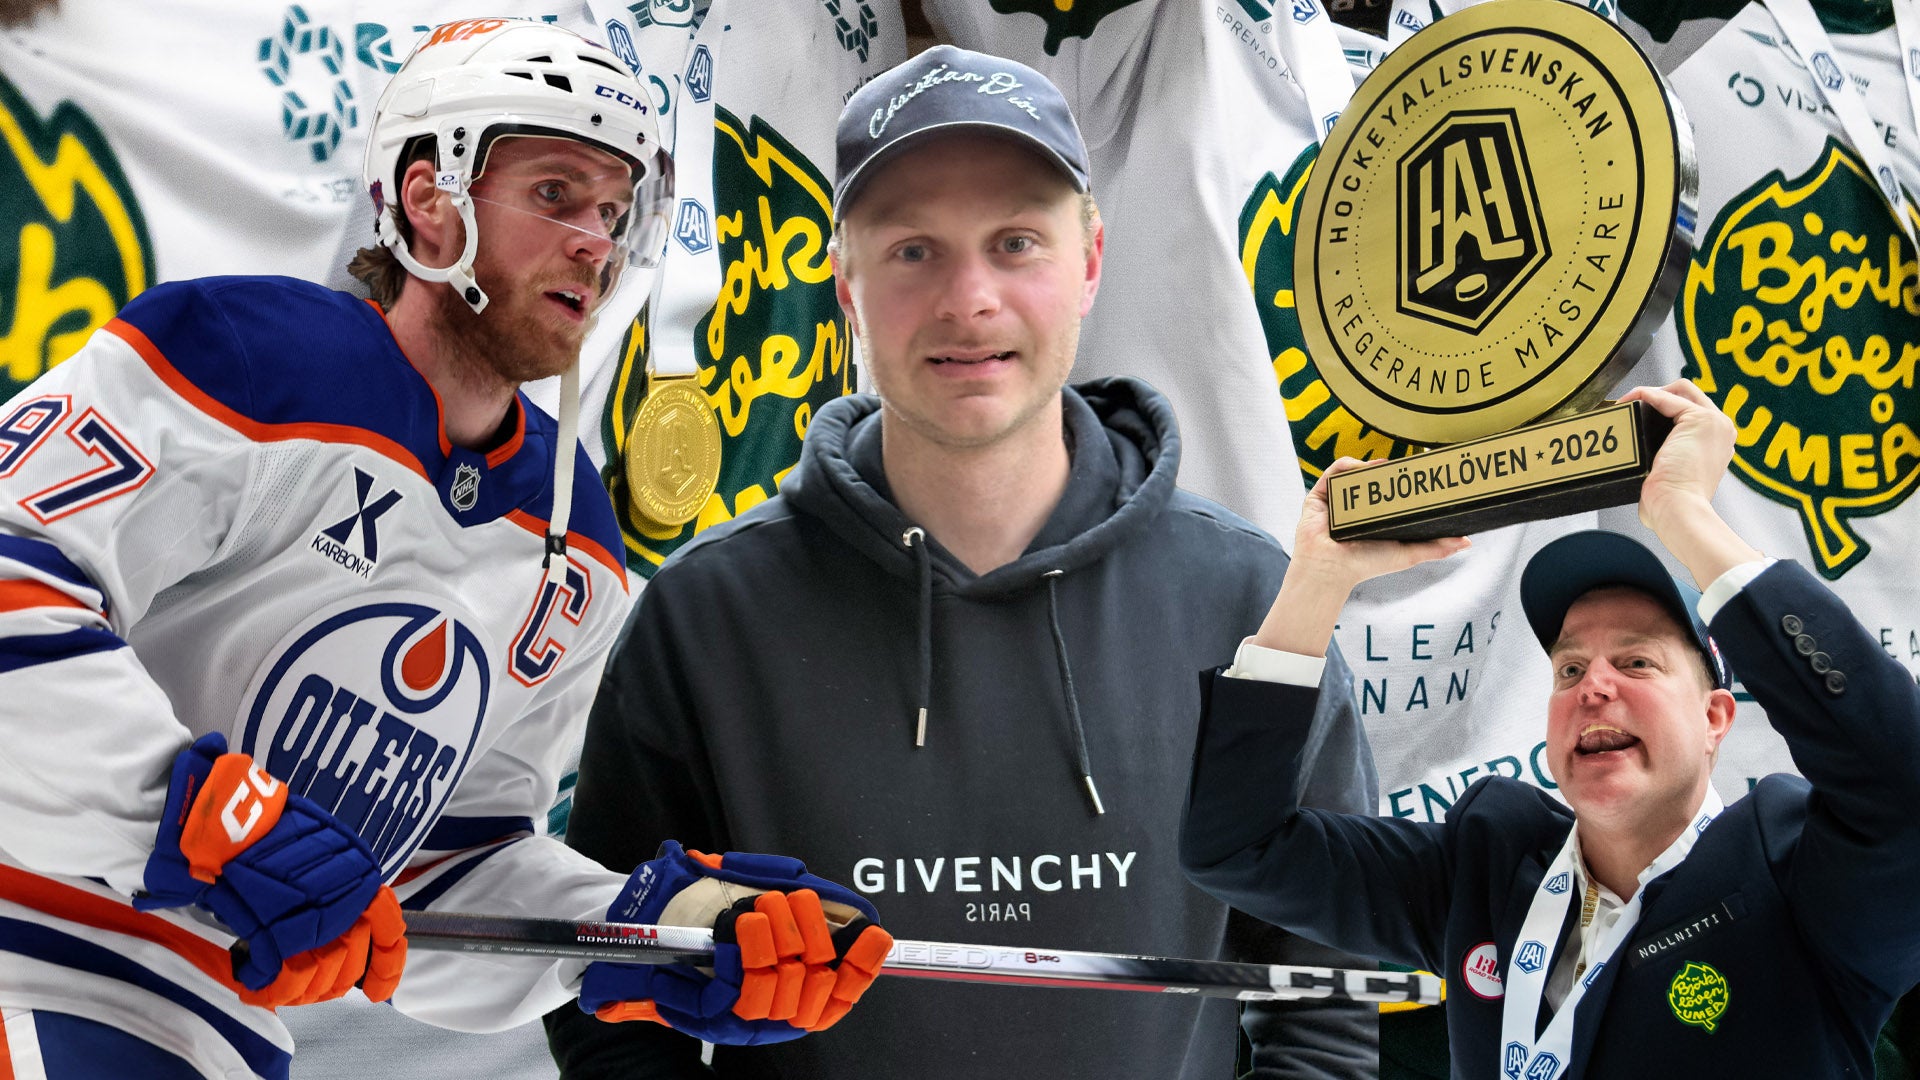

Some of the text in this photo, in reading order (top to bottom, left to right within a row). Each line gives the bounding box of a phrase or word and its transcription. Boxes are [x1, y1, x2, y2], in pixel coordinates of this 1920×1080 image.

[594, 84, 648, 115] CCM
[869, 63, 984, 139] Christian
[978, 72, 1041, 120] Dior
[1329, 48, 1613, 244] HOCKEYALLSVENSKAN
[1335, 193, 1625, 395] REGERANDE MÄSTARE
[0, 394, 156, 526] 97
[1342, 426, 1618, 511] IF BJÖRKLÖVEN 2026
[456, 483, 474, 498] NHL
[311, 535, 373, 579] KARBON-X
[508, 556, 592, 688] C
[266, 674, 457, 873] OILERS
[853, 852, 1136, 893] GIVENCHY
[1638, 914, 1719, 958] NOLLNITTI
[1468, 966, 1487, 978] ROAD
[1683, 999, 1723, 1020] UMEÅ
